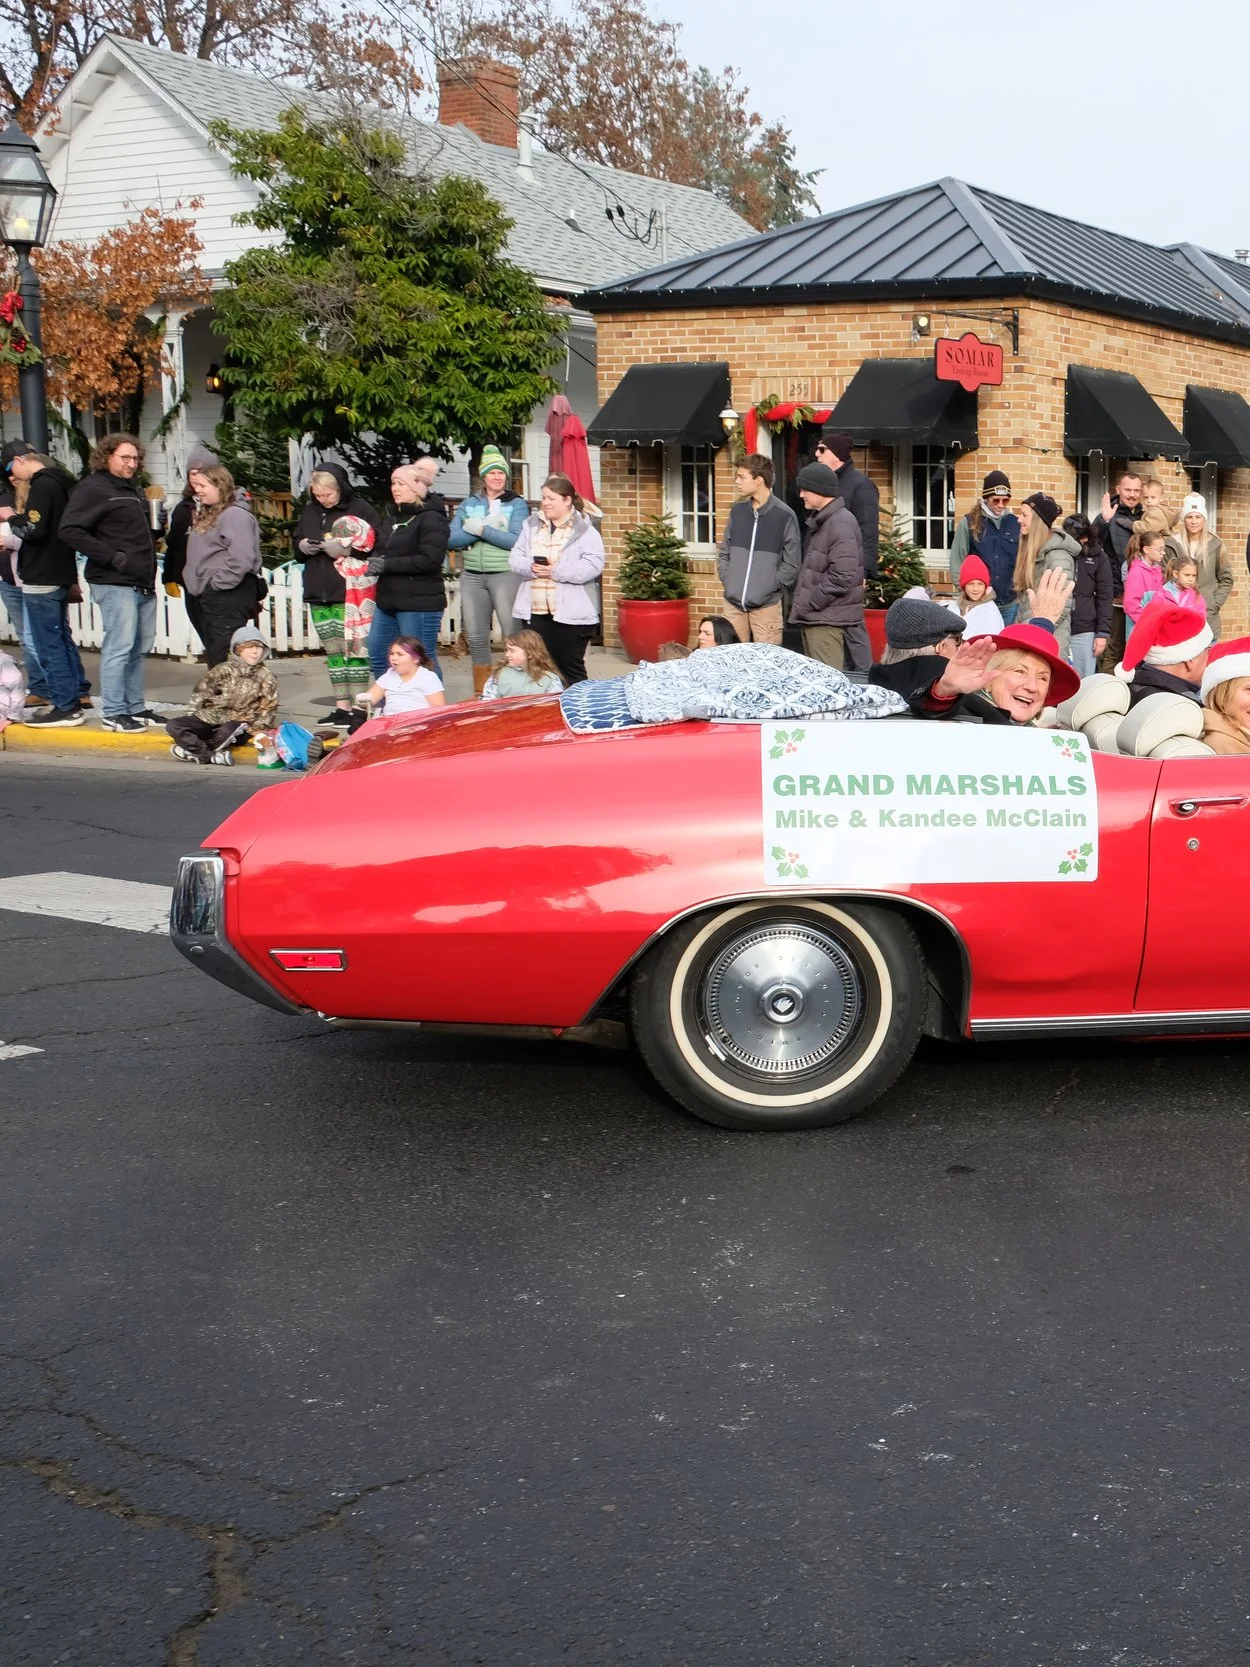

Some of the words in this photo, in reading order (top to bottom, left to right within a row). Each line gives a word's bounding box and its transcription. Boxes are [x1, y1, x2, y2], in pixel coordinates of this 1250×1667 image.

[944, 345, 994, 368] SOMAR
[789, 383, 809, 397] 255
[772, 774, 895, 797] GRAND
[906, 774, 1087, 797] MARSHALS
[775, 809, 839, 829] Mike
[848, 809, 868, 828] &
[878, 809, 977, 828] Kandee
[986, 808, 1087, 828] McClain
